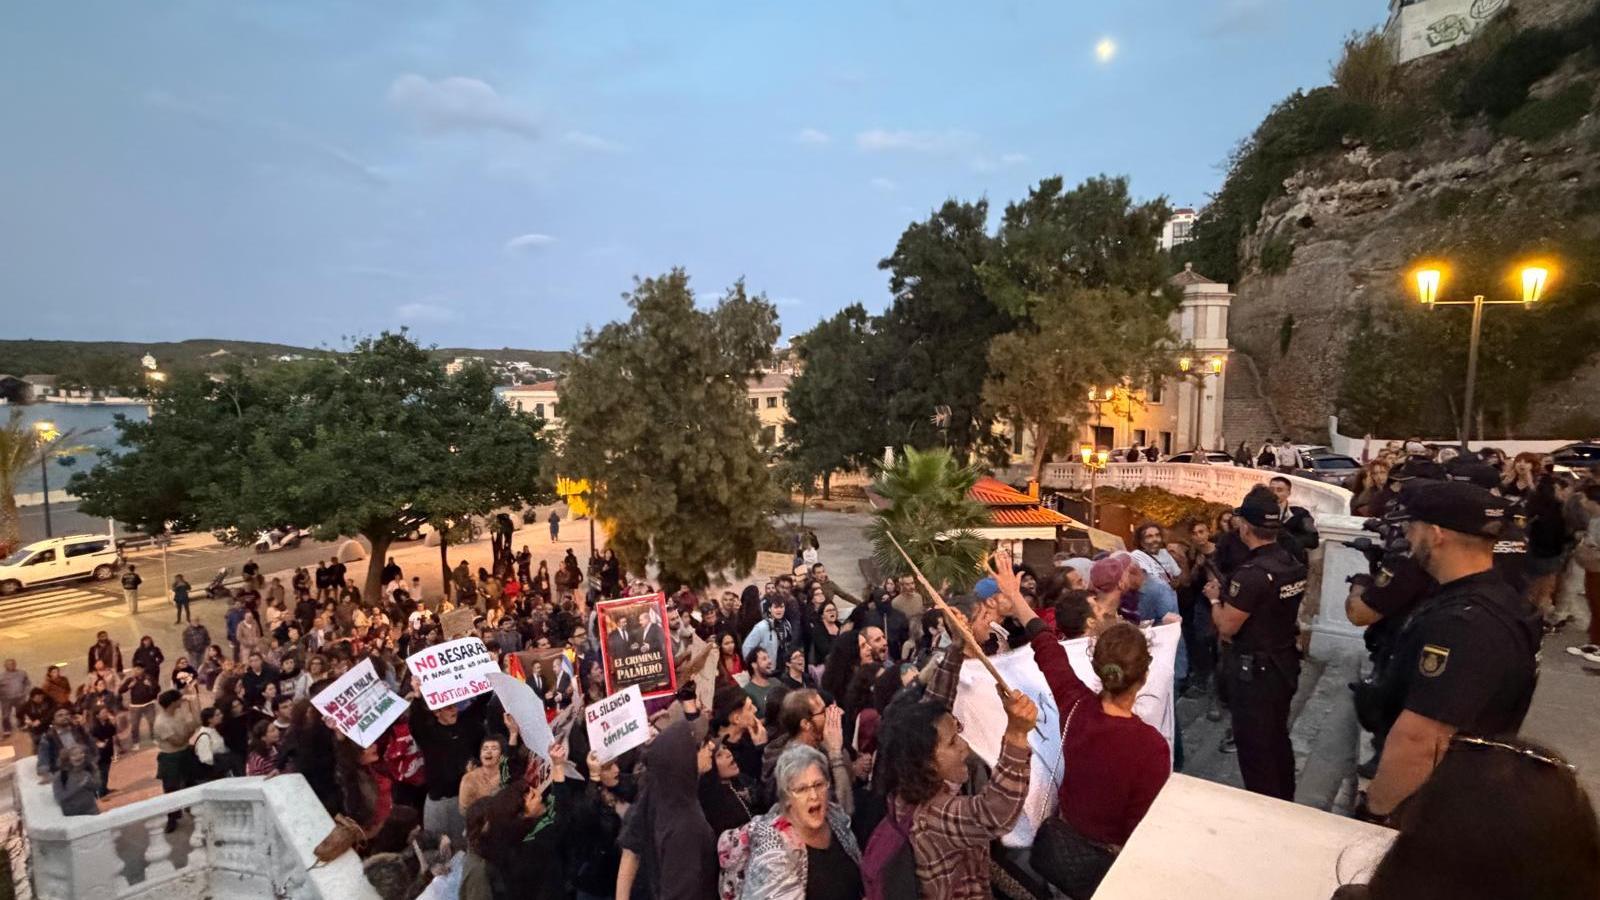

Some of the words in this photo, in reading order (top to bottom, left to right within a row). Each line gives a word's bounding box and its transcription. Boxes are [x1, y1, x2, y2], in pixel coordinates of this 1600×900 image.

[415, 655, 438, 672] NO
[454, 664, 465, 672] QUE
[614, 658, 624, 668] EL
[625, 651, 662, 666] CRIMINAL
[616, 663, 662, 680] PALMERO
[334, 692, 347, 706] ES
[426, 686, 470, 705] JUSTICIA
[588, 710, 599, 723] EL
[599, 693, 631, 716] SILENCIO
